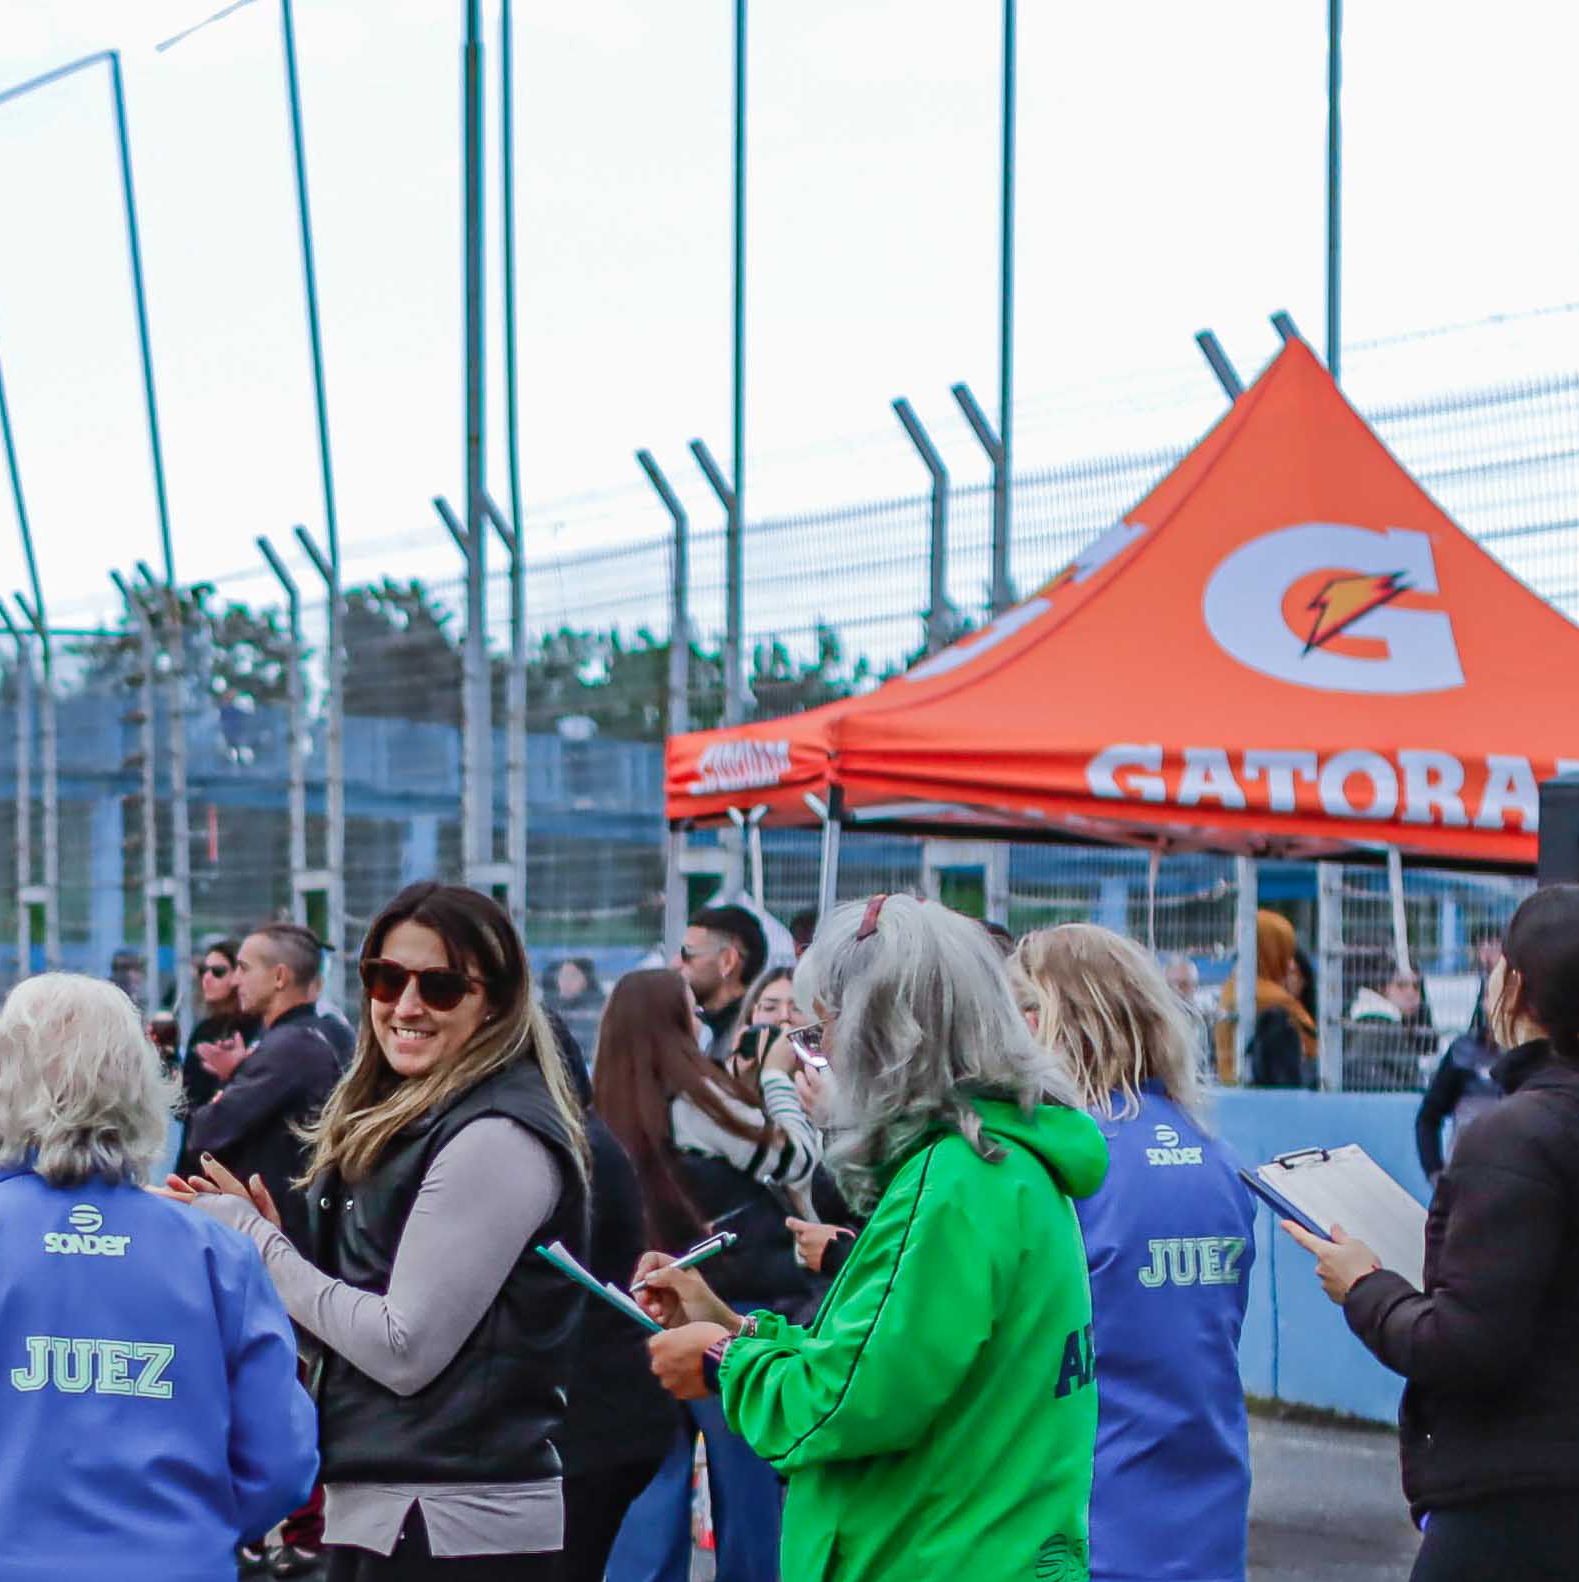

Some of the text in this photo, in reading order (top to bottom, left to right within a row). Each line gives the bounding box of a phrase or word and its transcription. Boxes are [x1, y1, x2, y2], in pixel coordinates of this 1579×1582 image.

[1201, 521, 1465, 694] G
[1085, 743, 1579, 833] GATORA
[1138, 1237, 1246, 1288] JUEZ
[10, 1335, 175, 1399] JUEZ
